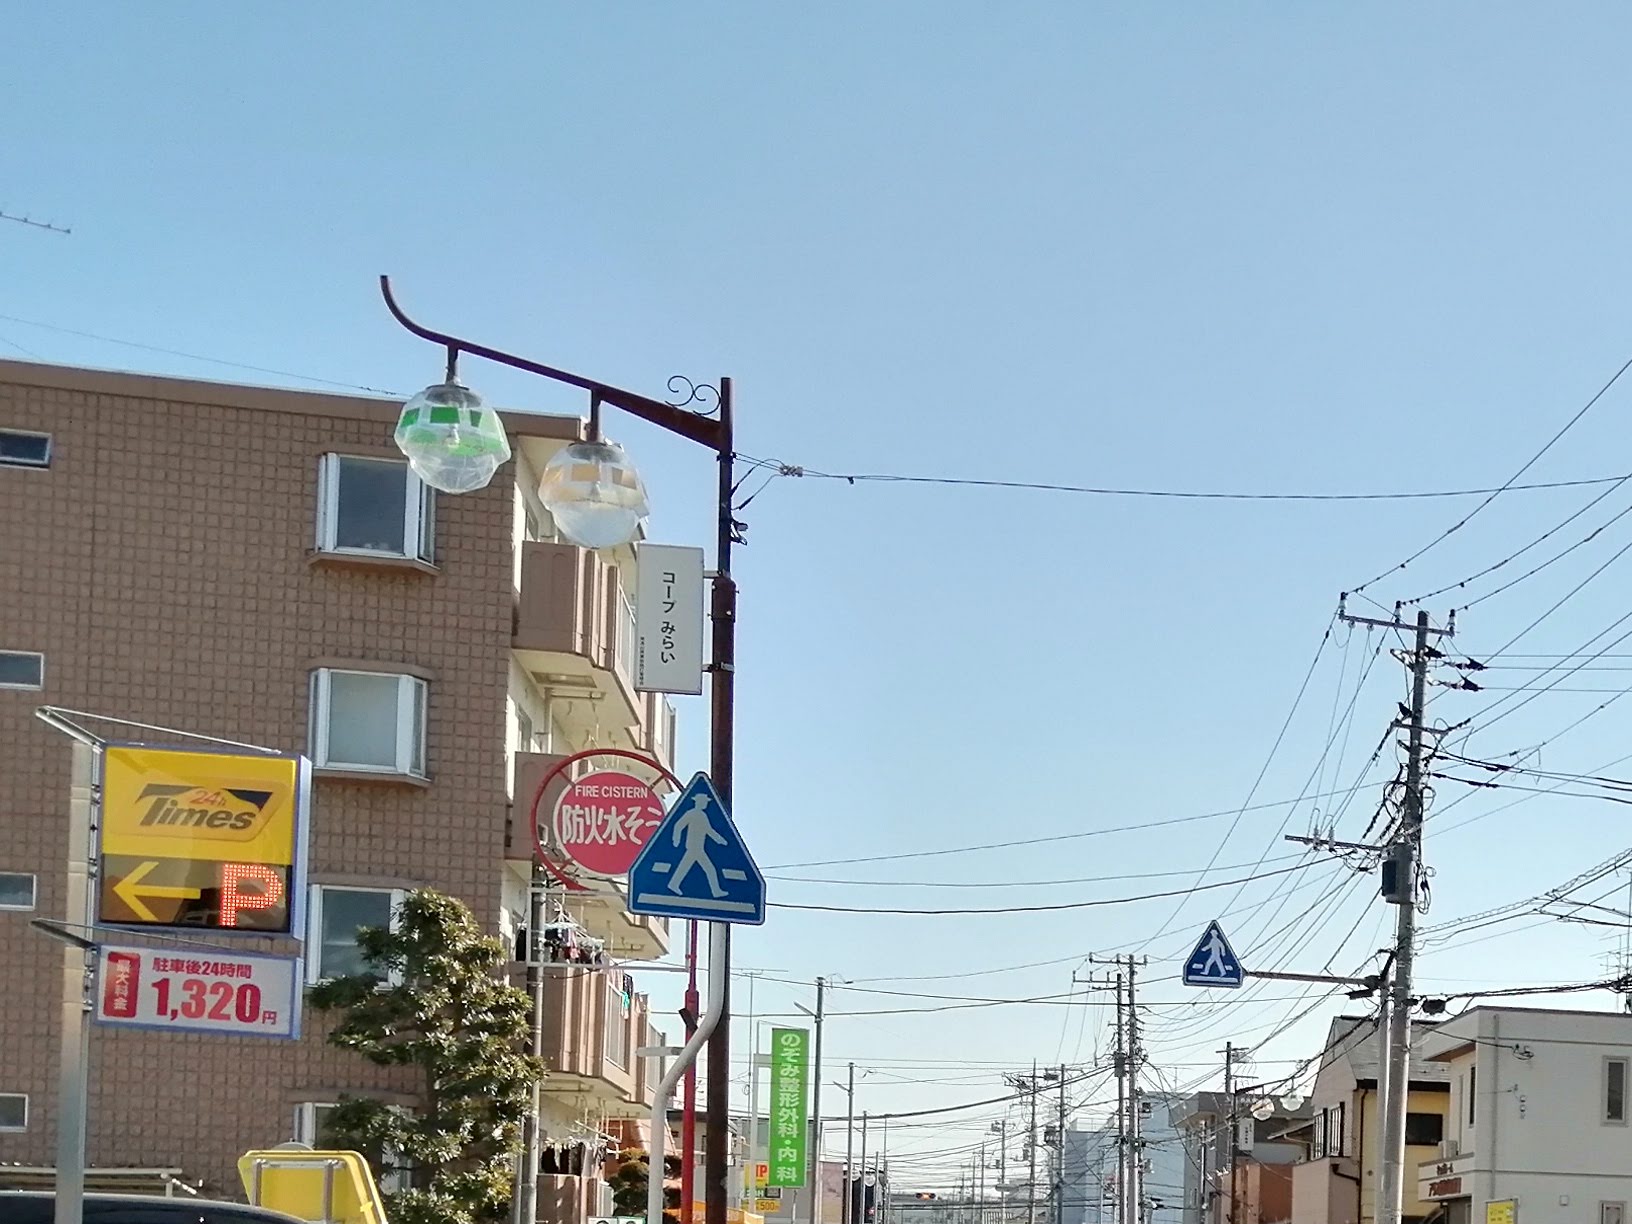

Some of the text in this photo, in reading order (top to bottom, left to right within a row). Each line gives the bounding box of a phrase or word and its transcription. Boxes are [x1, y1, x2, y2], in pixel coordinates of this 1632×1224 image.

[135, 783, 257, 830] Times
[575, 785, 648, 799] FIRE CISTERN
[220, 863, 283, 927] P
[152, 957, 252, 979] 駐車後24時間
